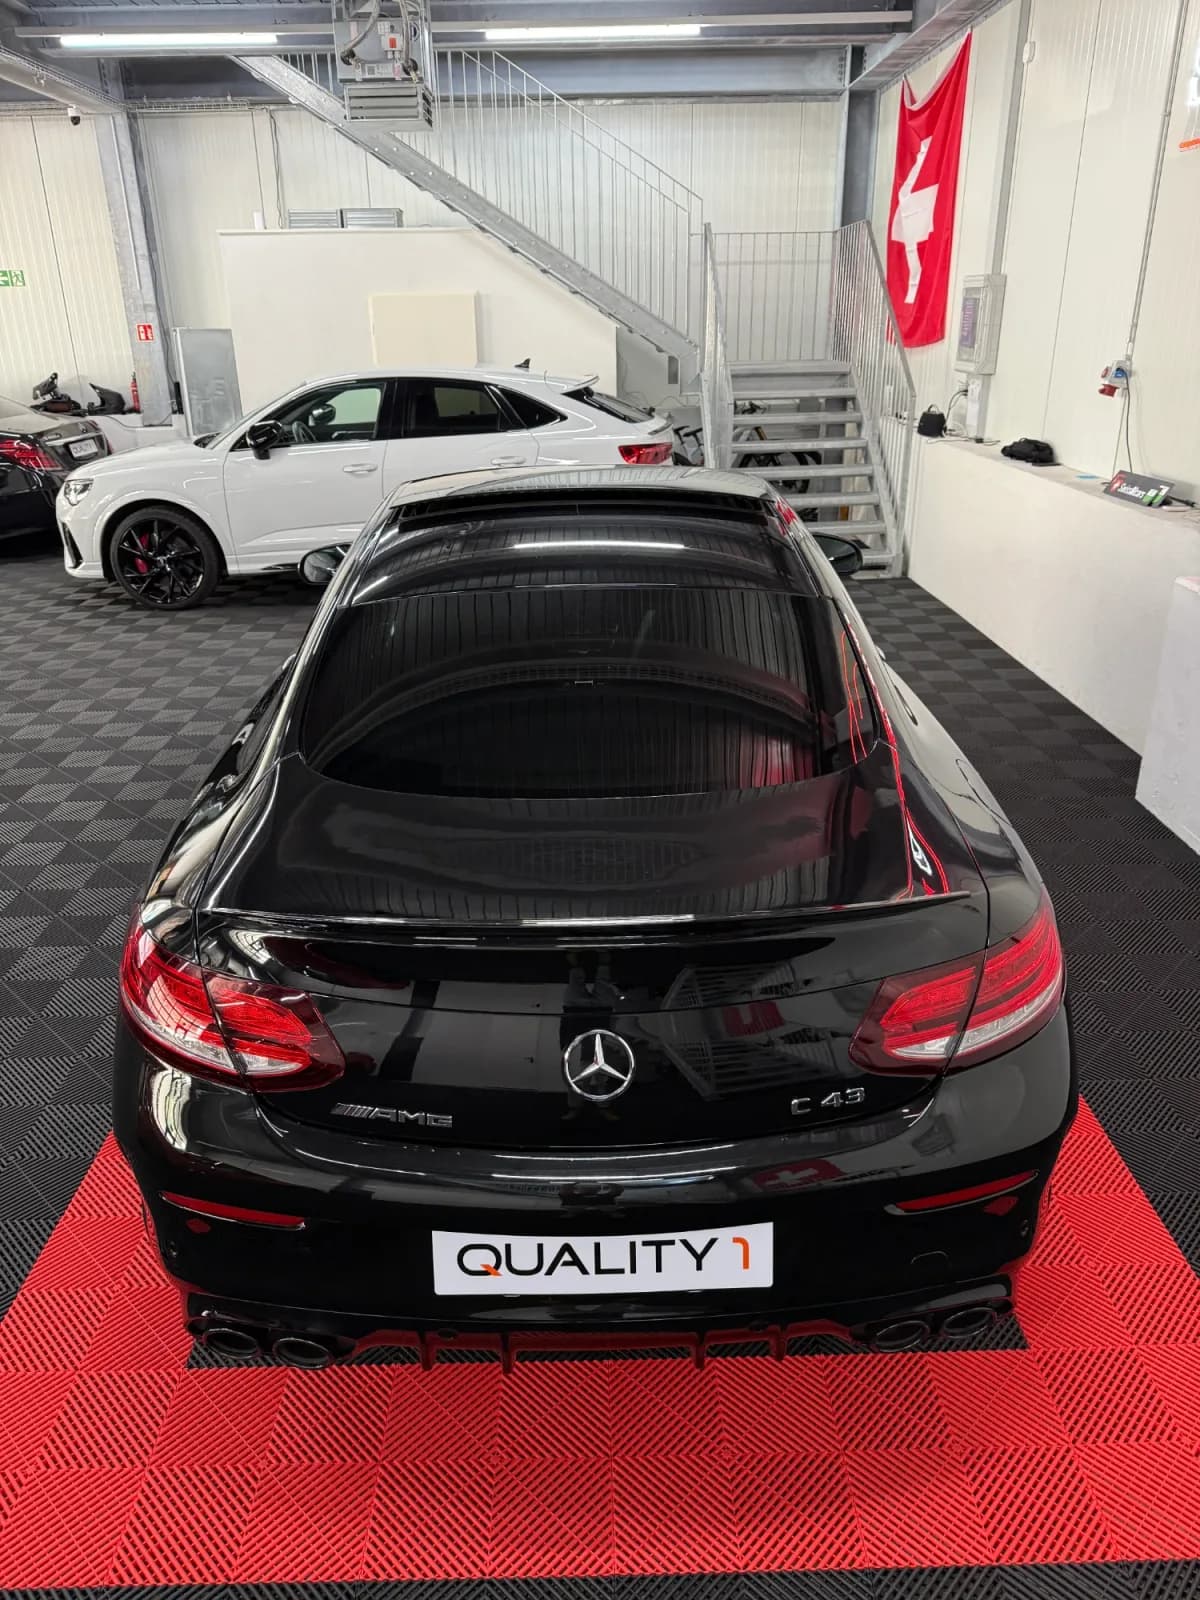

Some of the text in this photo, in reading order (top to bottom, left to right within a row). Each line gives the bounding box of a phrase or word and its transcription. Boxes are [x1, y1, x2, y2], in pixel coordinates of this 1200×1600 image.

[791, 1088, 865, 1115] C 43
[456, 1238, 719, 1276] QUALITY
